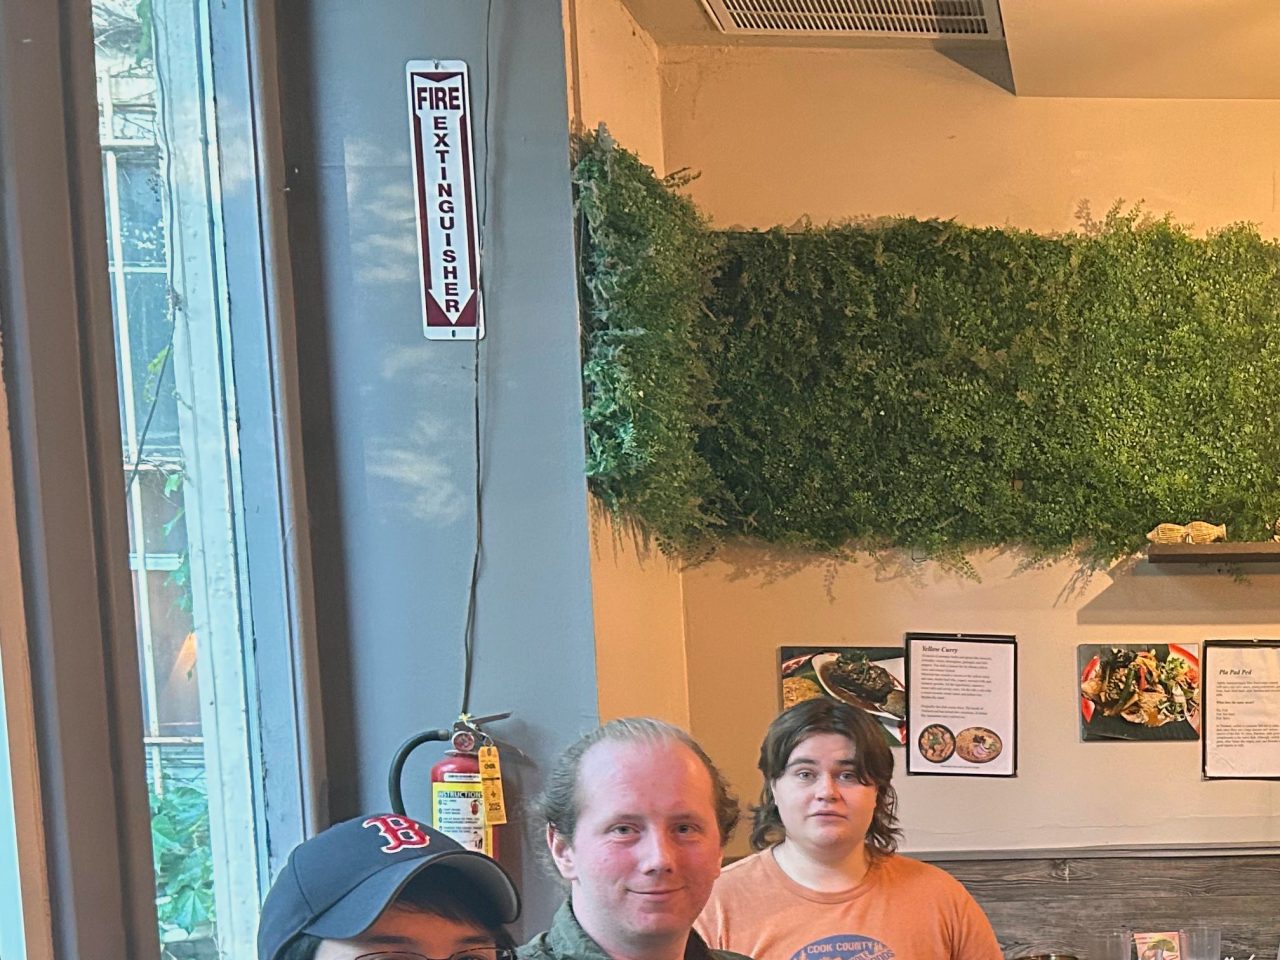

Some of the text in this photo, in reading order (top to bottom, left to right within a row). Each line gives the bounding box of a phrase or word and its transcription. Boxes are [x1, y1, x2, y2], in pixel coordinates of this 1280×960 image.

[416, 86, 461, 111] FIRE
[433, 116, 460, 313] EXTINGUISHER
[941, 646, 958, 654] Curry
[361, 813, 431, 854] B
[807, 941, 874, 954] COOK COUNTY
